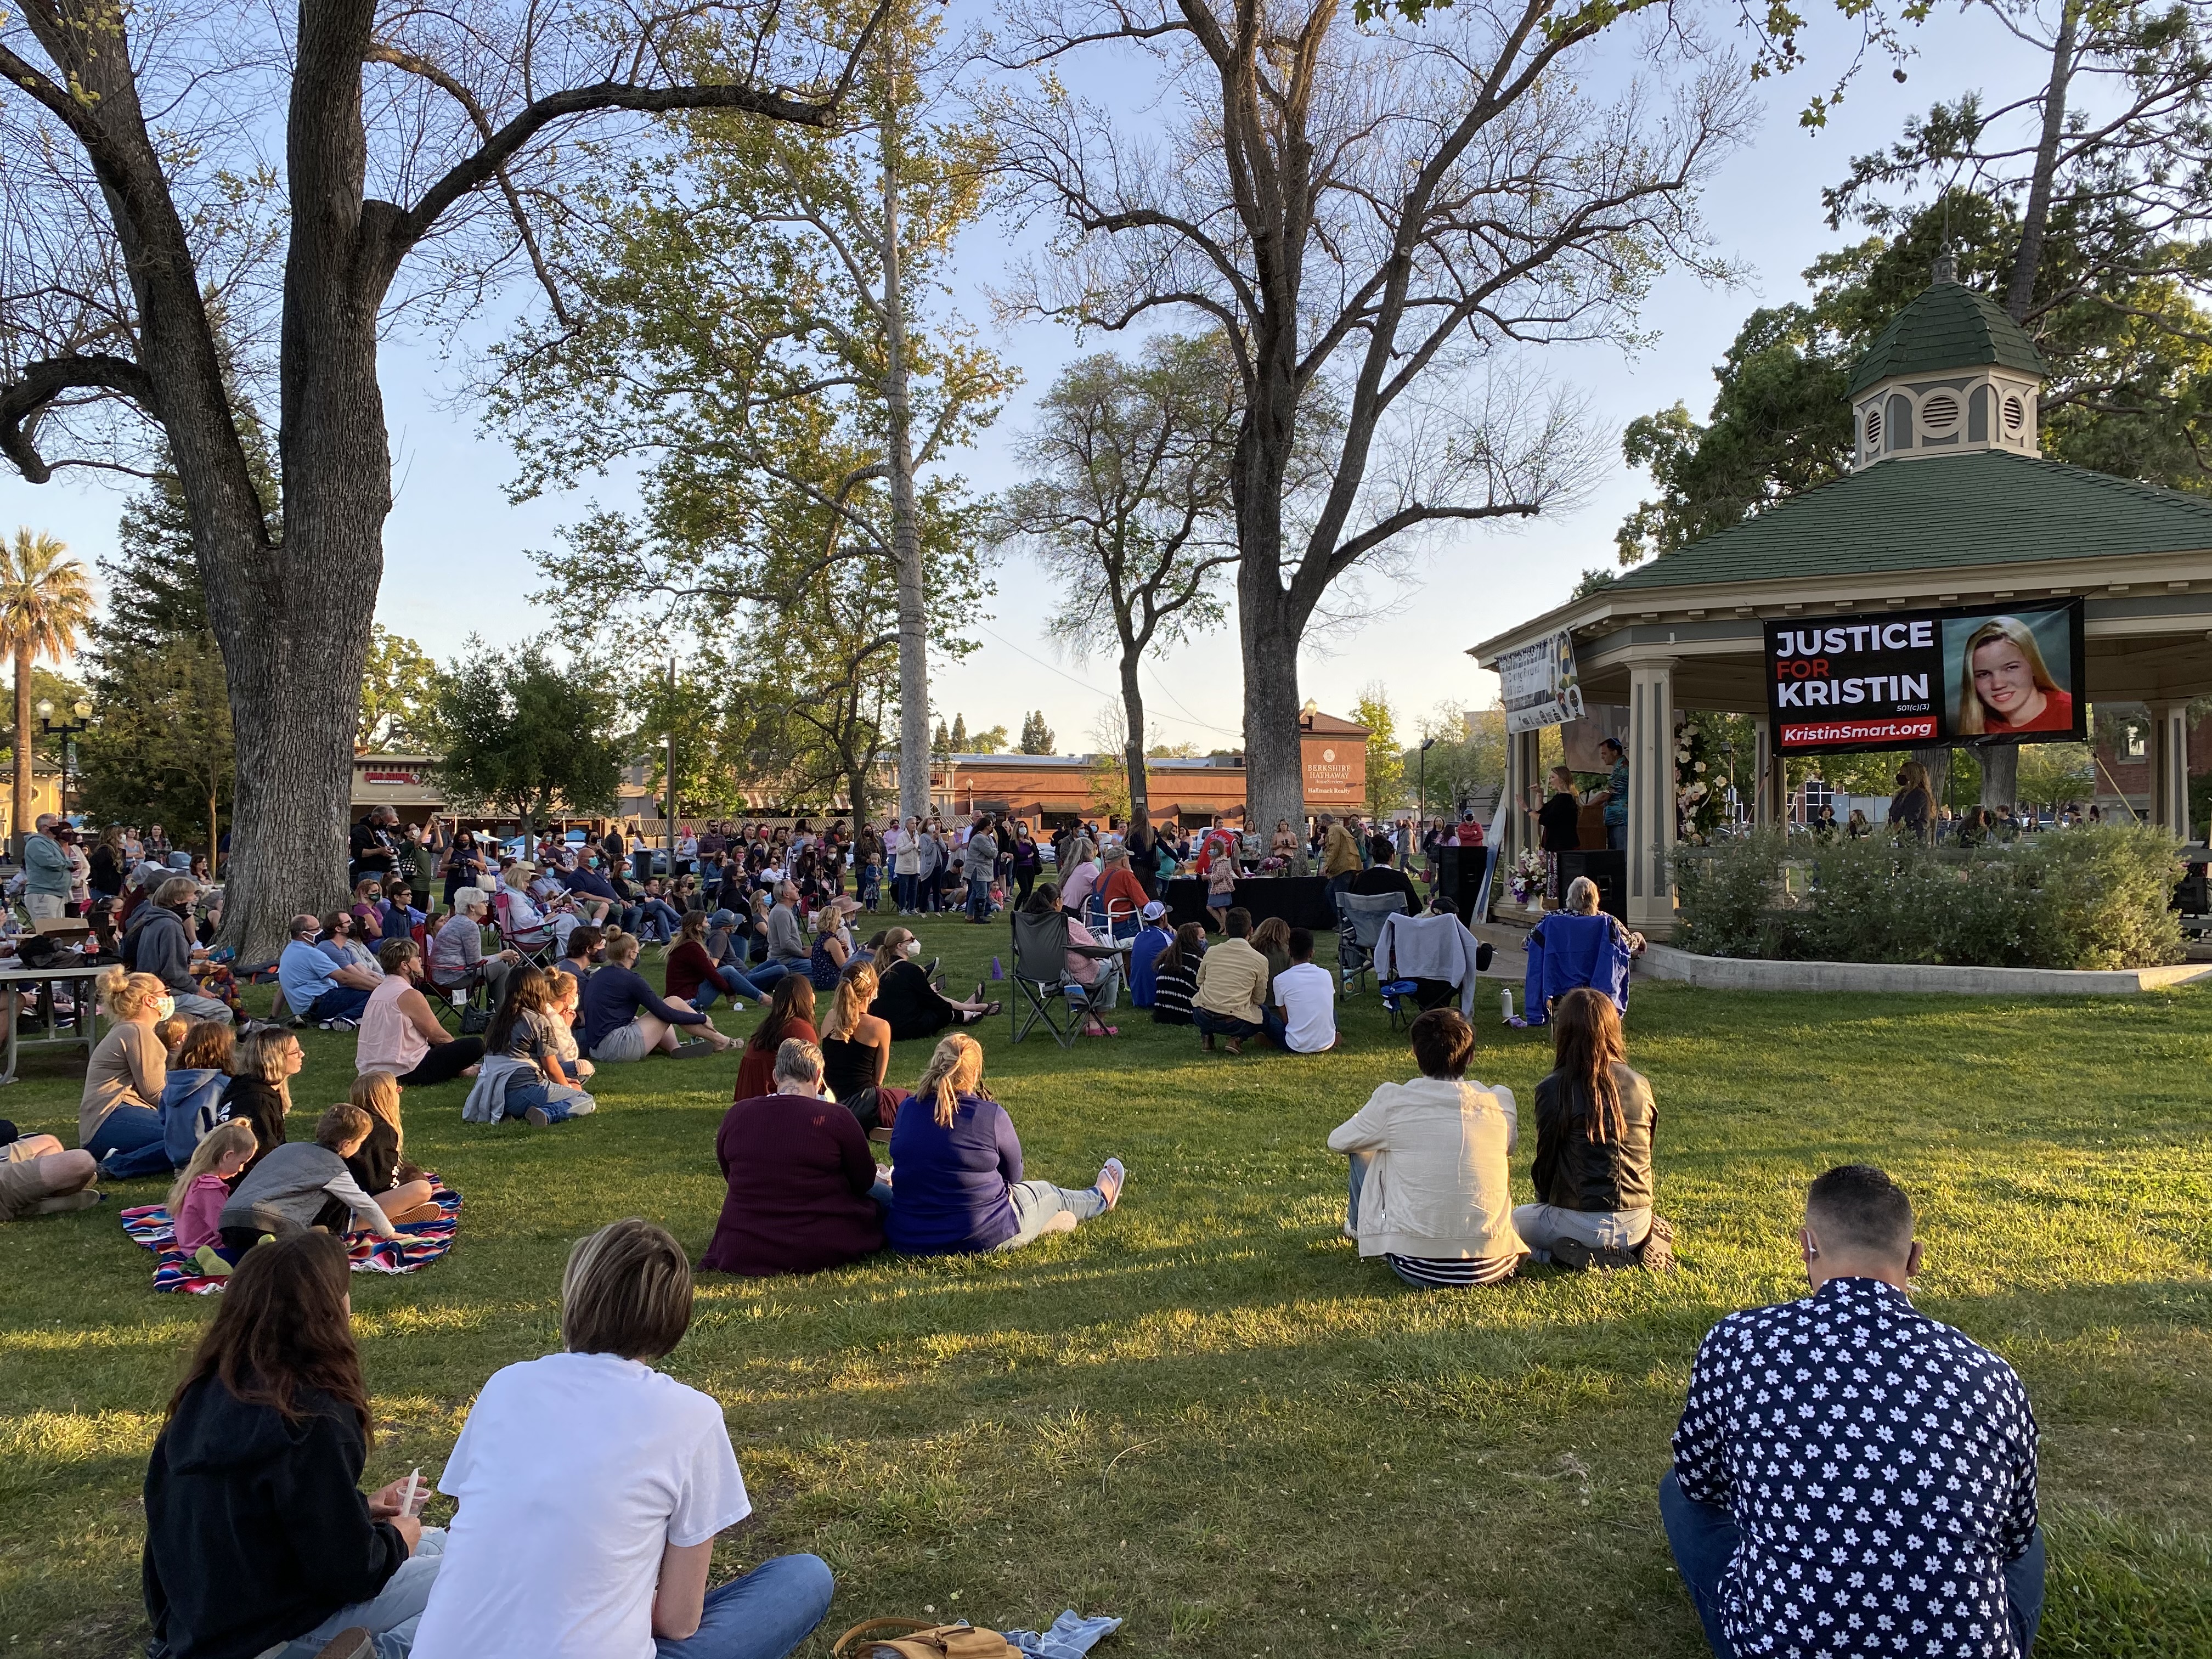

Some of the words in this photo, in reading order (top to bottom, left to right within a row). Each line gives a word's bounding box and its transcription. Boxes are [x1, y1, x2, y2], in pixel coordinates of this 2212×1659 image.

[1776, 620, 1933, 657] JUSTICE
[1776, 659, 1830, 680] FOR
[1778, 673, 1929, 708] KRISTIN
[1896, 703, 1930, 712] 501(c)(3)
[1784, 723, 1932, 741] KristinSmart.org
